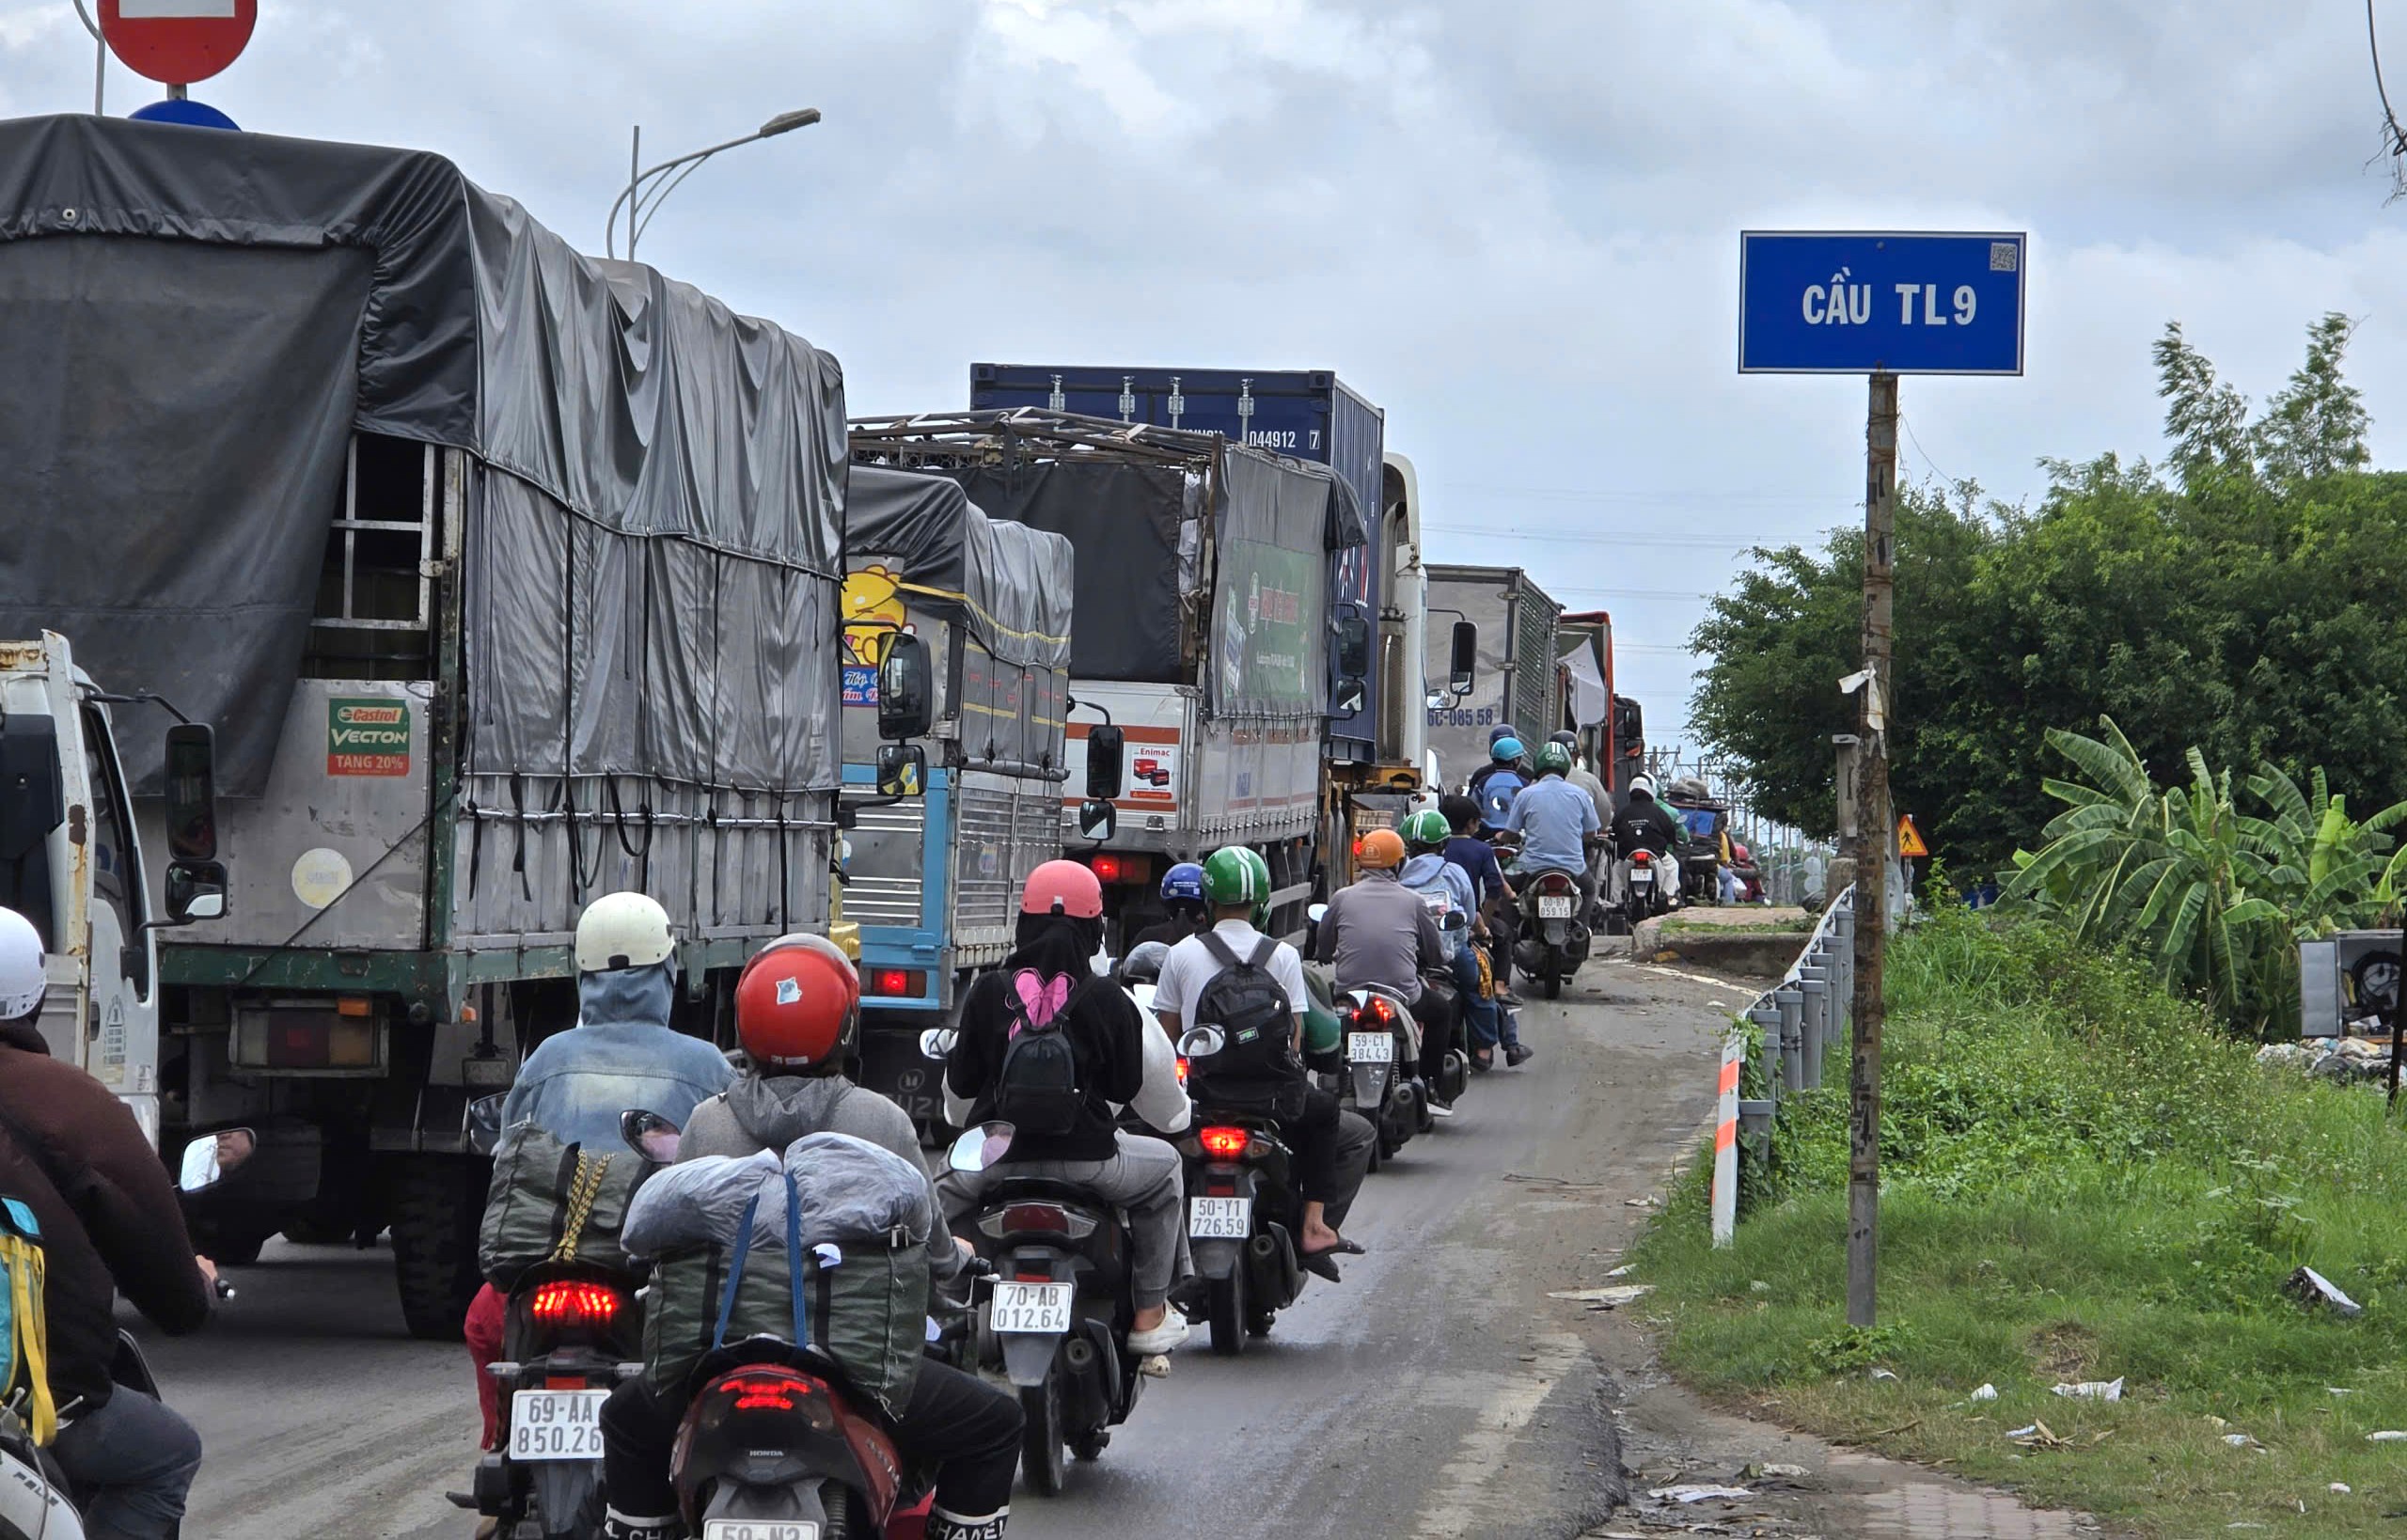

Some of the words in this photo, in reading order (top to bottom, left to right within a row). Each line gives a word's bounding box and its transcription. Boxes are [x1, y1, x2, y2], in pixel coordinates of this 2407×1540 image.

[1801, 266, 1871, 324] CẦU
[1895, 283, 1977, 325] TL9
[1249, 430, 1297, 448] 044912
[353, 708, 398, 722] Castrol
[1140, 747, 1171, 757] Enimac
[1545, 752, 1565, 762] Grab
[375, 755, 403, 769] 20%
[1198, 1199, 1241, 1217] 50-Y1
[1193, 1218, 1245, 1235] 726.59
[1007, 1286, 1059, 1307] 70-AB
[997, 1307, 1064, 1329] 012.64
[528, 1396, 592, 1423] 69-AA
[517, 1426, 602, 1454] 850.26
